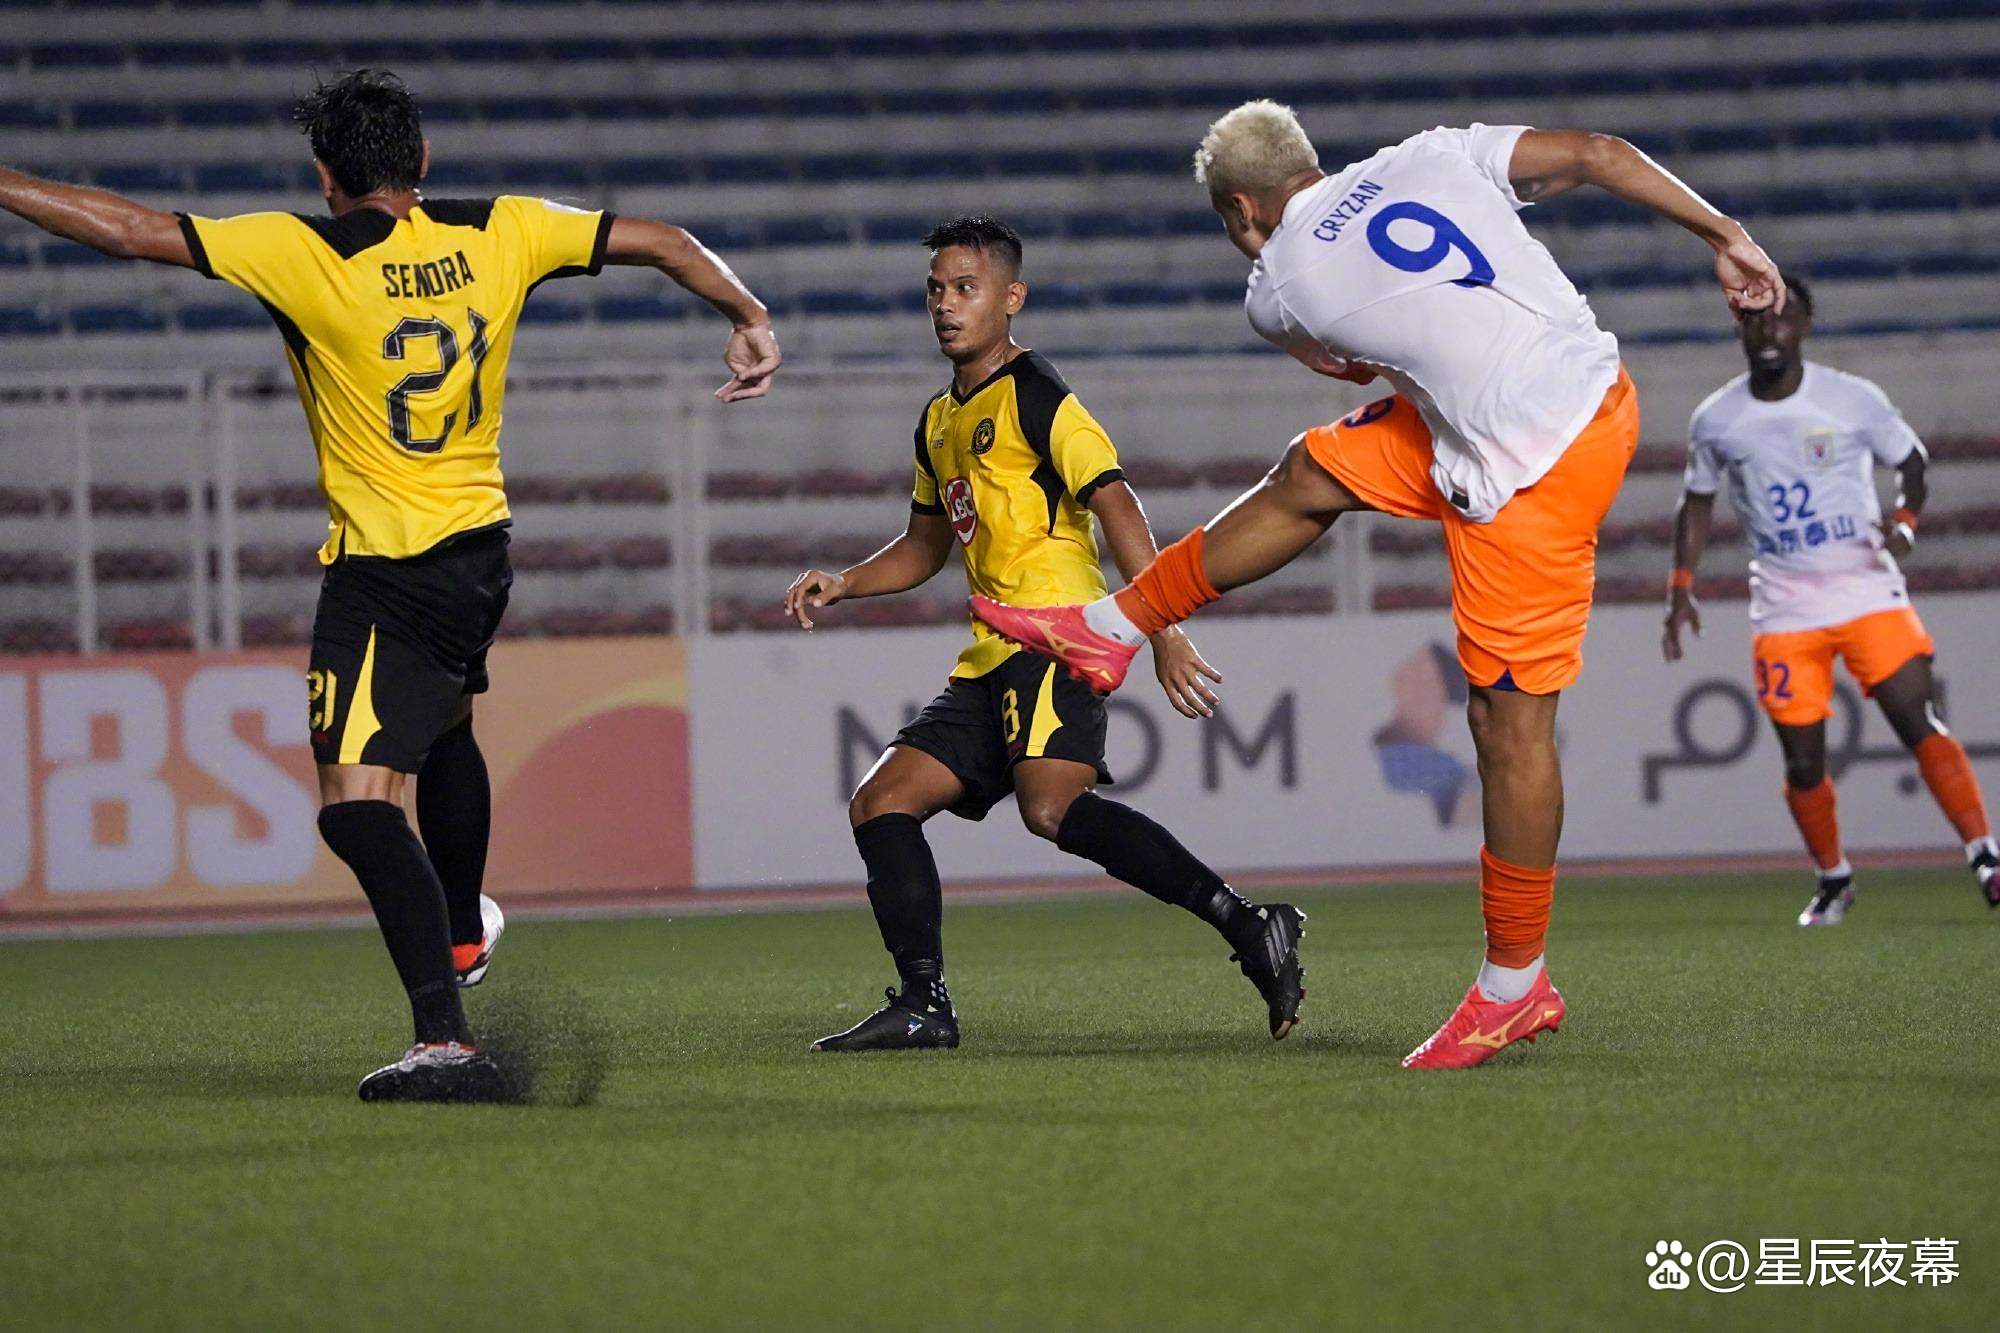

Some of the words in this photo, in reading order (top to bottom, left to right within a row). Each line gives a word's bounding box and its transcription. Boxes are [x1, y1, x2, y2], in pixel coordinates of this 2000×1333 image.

[1313, 179, 1383, 242] CRYZAN
[1366, 201, 1496, 288] 9
[383, 306, 488, 454] 21
[1768, 479, 1816, 523] 32
[1002, 687, 1021, 744] 8
[1756, 659, 1793, 698] 32
[0, 665, 318, 894] BS
[836, 690, 1300, 806] NOM
